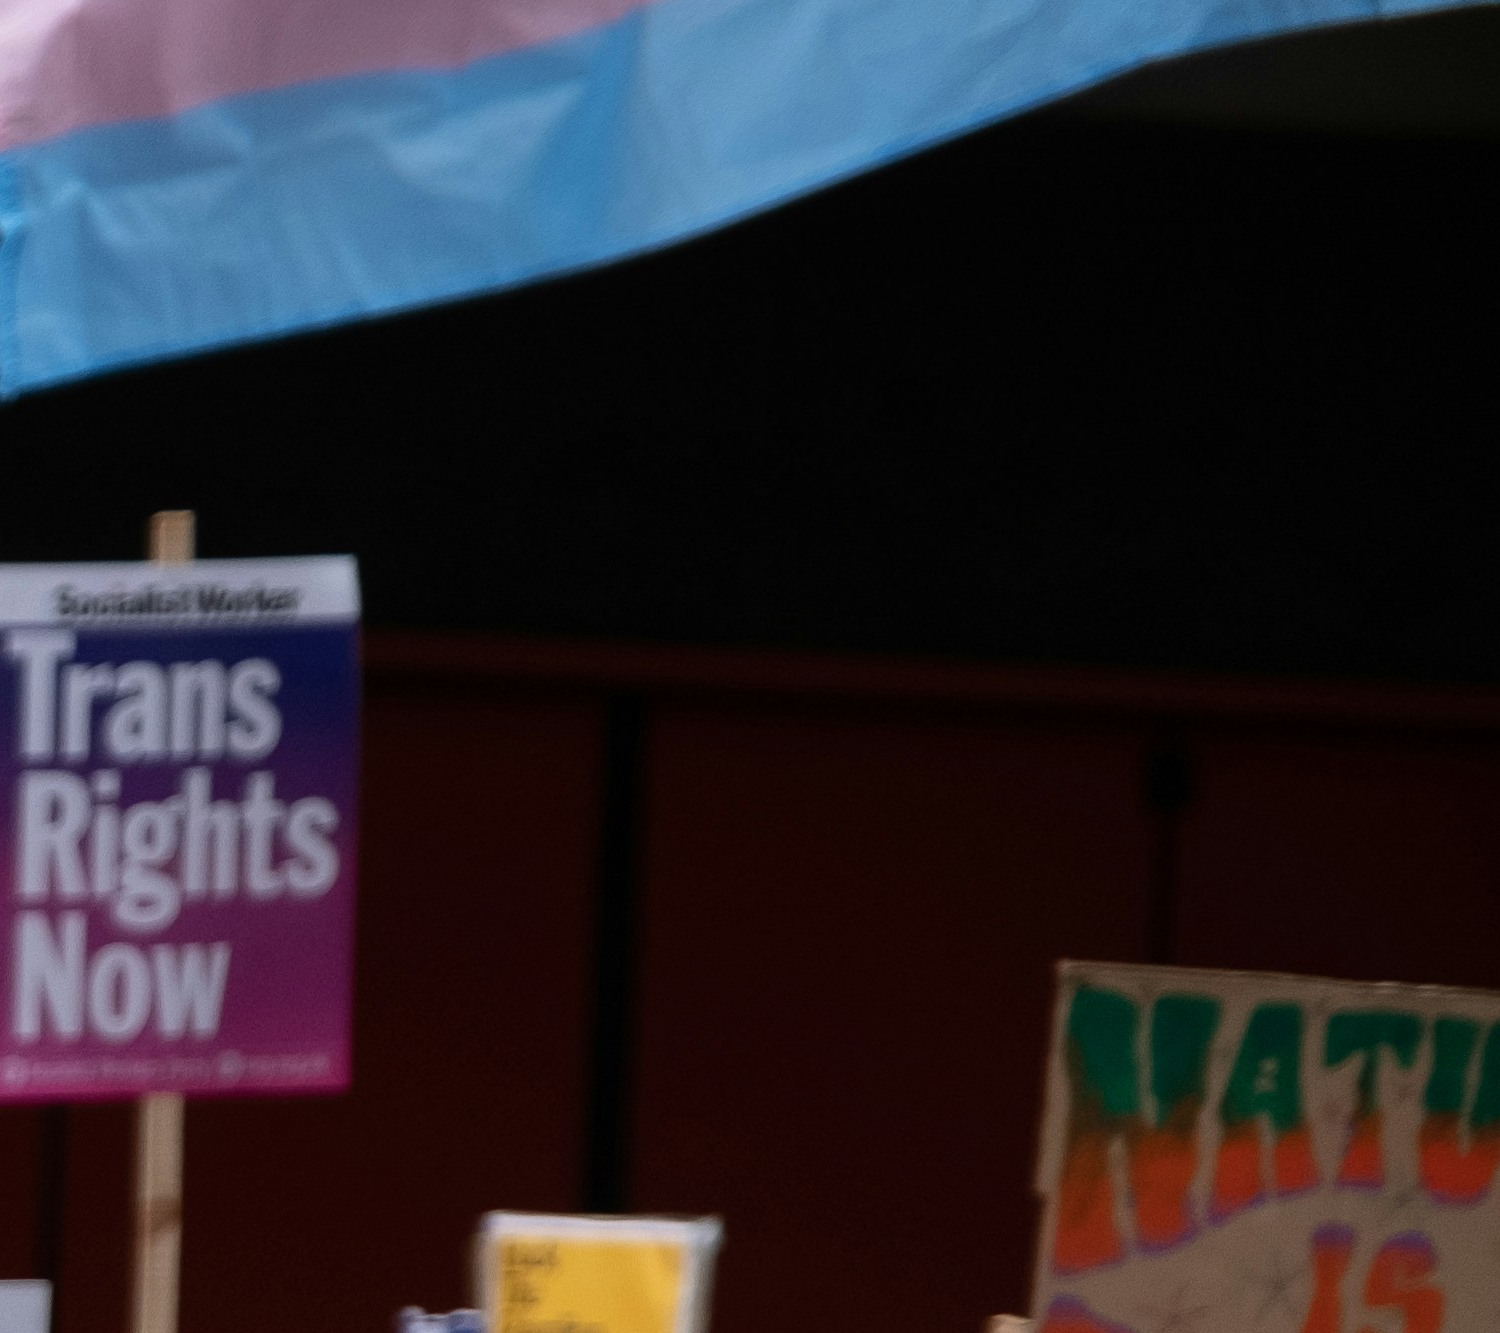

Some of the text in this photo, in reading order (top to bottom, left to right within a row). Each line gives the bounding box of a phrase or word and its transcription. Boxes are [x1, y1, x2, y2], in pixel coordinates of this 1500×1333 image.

[4, 629, 282, 762] Trans
[13, 765, 340, 931] Rights
[11, 909, 232, 1042] Now
